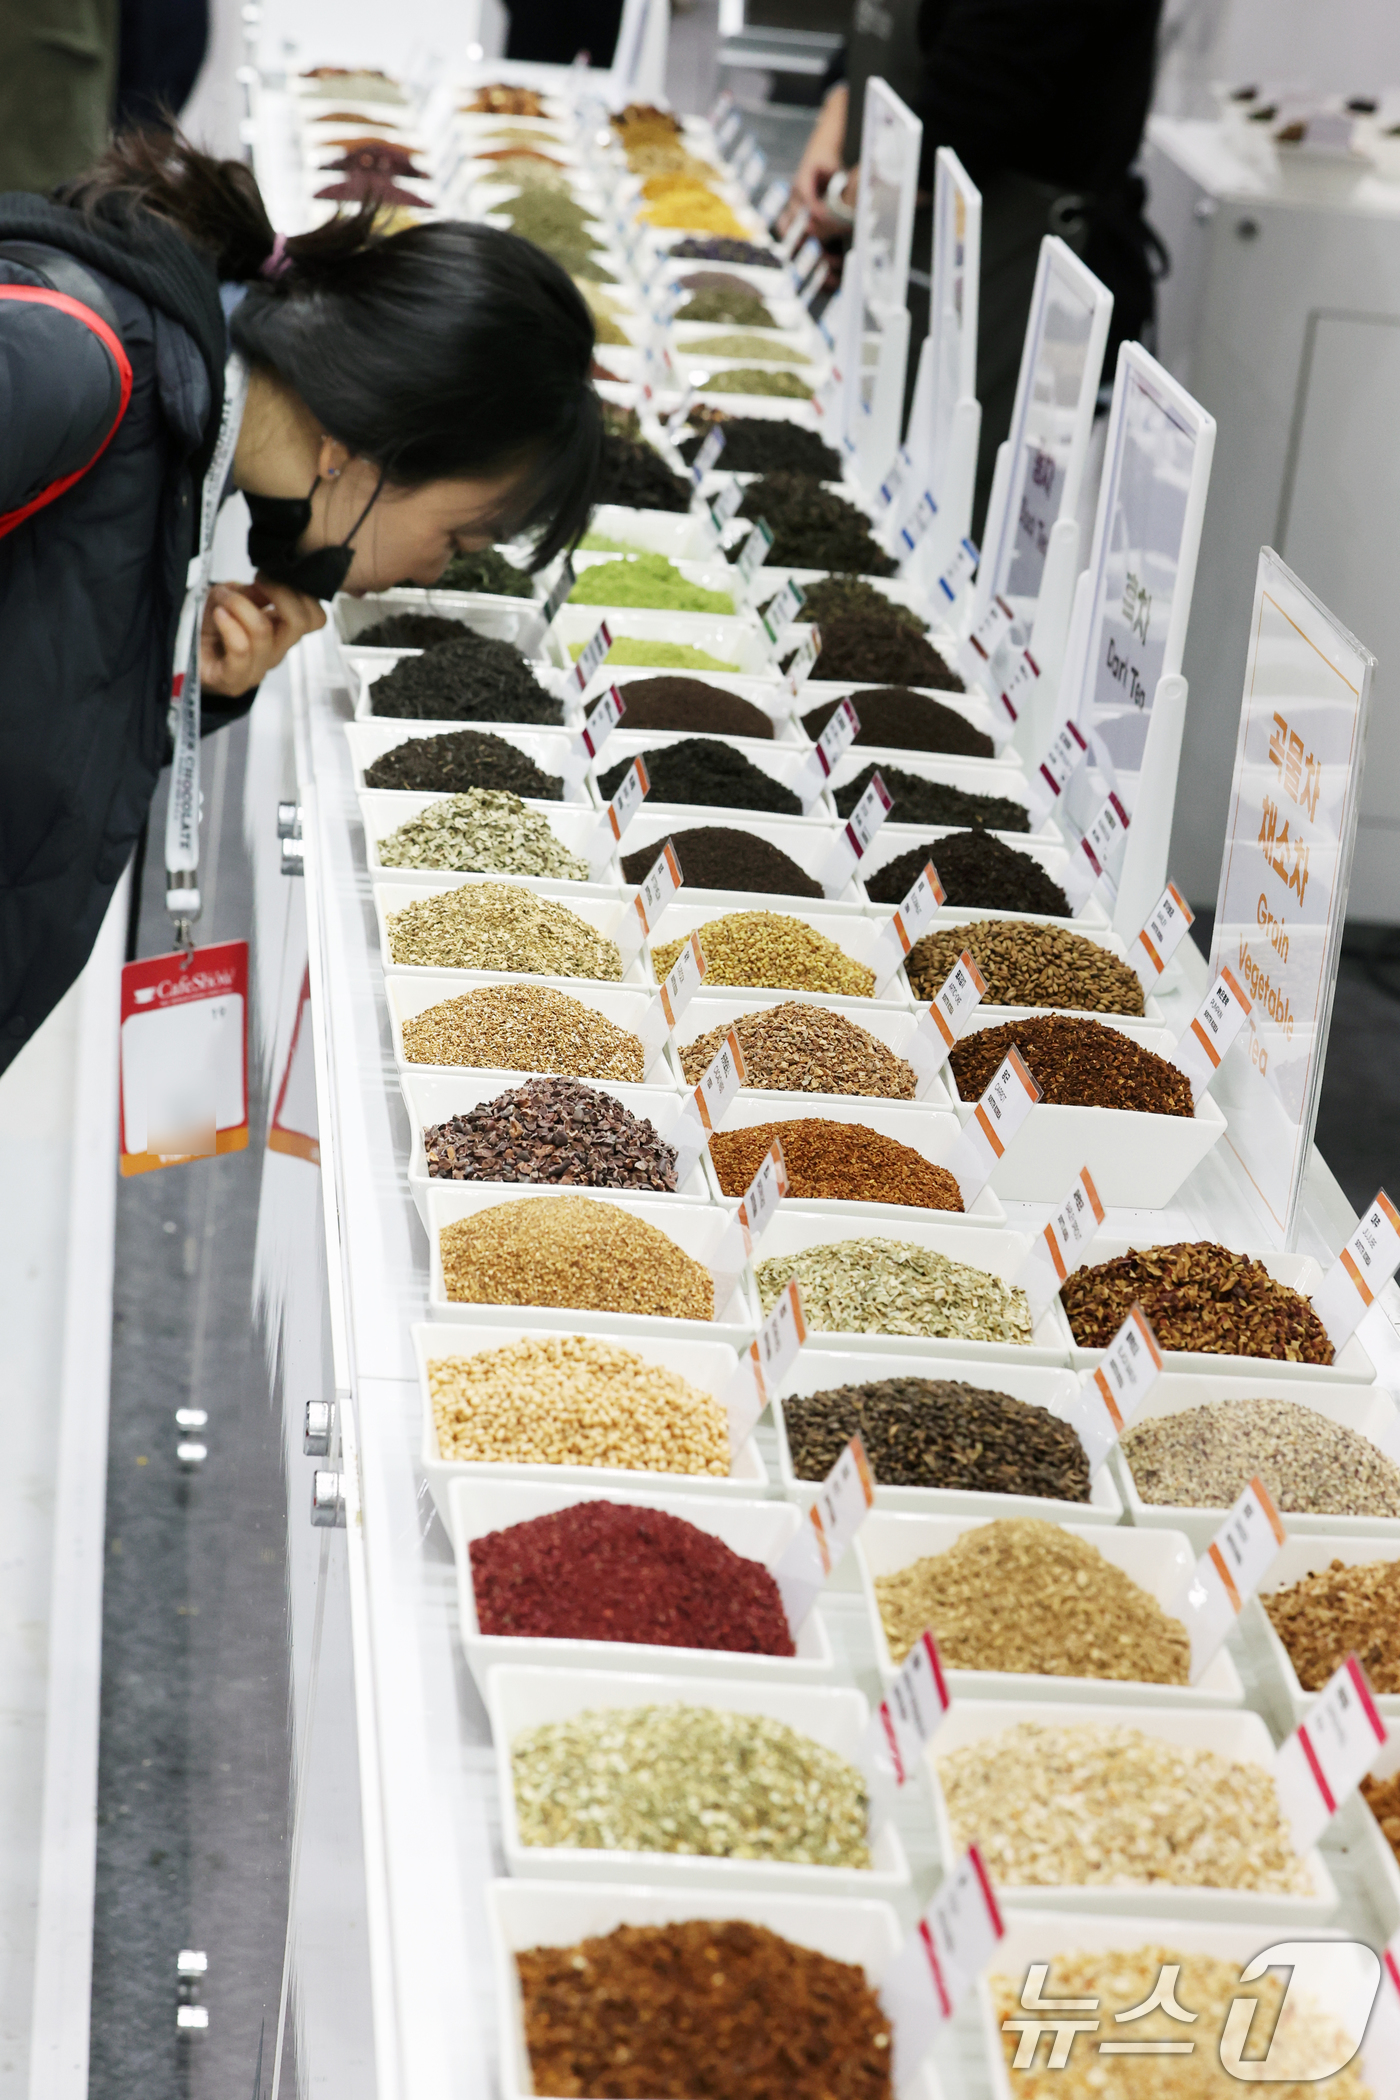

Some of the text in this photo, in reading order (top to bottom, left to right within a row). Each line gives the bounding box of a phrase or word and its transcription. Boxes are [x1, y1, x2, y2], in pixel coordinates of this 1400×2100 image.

[1270, 711, 1322, 822] 곡물차
[1257, 794, 1310, 907] 채소차
[1257, 893, 1289, 964] Grain
[954, 969, 966, 989] 돼지감자
[1215, 985, 1229, 1007] 늙은호박
[1238, 933, 1294, 1042] Vegetable
[1000, 1068, 1011, 1085] 당근
[1247, 1019, 1269, 1077] Tea
[1370, 1212, 1381, 1229] 대추
